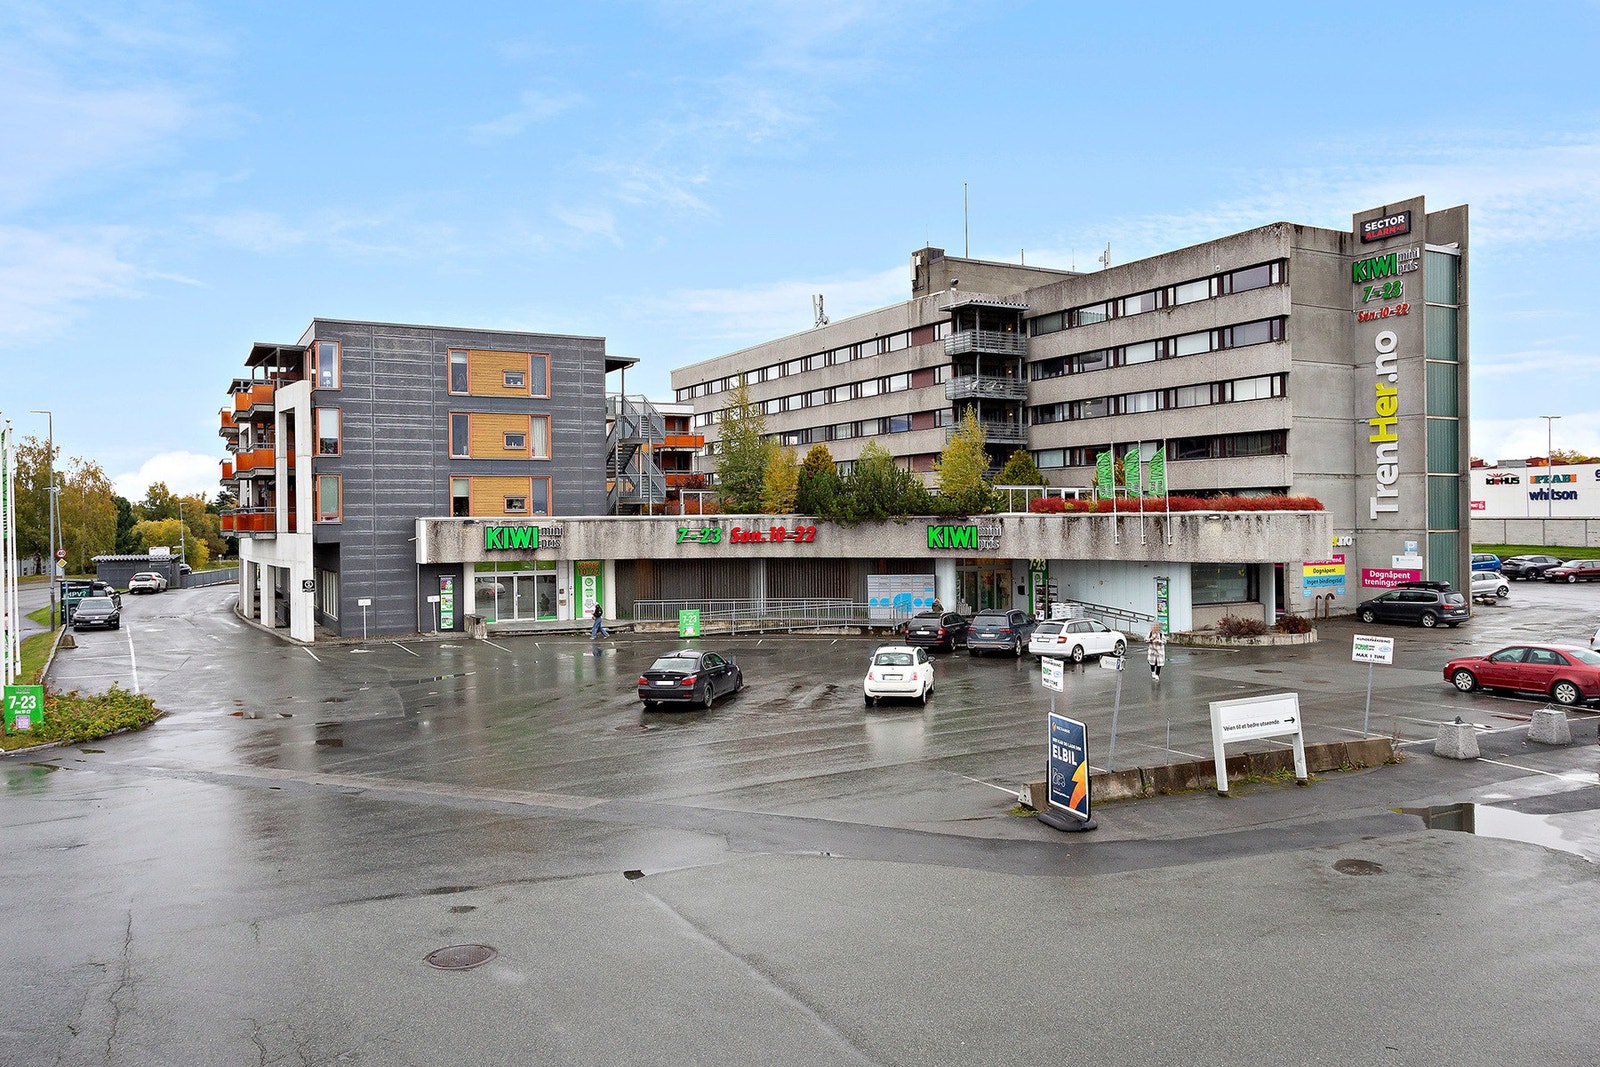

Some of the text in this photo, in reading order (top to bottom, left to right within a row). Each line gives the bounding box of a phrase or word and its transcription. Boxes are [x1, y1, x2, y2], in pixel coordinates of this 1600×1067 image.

[1364, 215, 1405, 232] SECTOR
[1365, 227, 1397, 240] ALARM
[1353, 247, 1420, 283] KIWI mini
[1369, 330, 1399, 520] TrenHer.no
[1534, 474, 1571, 484] PEAB
[1529, 487, 1578, 501] whitson
[486, 525, 563, 549] KIWI mini
[541, 537, 561, 550] pris
[927, 525, 1002, 549] KIWI mini
[1369, 569, 1410, 580] Døgnåpent
[682, 615, 697, 623] 7-23
[8, 695, 37, 710] 7-23
[1052, 743, 1078, 766] ELBIL
